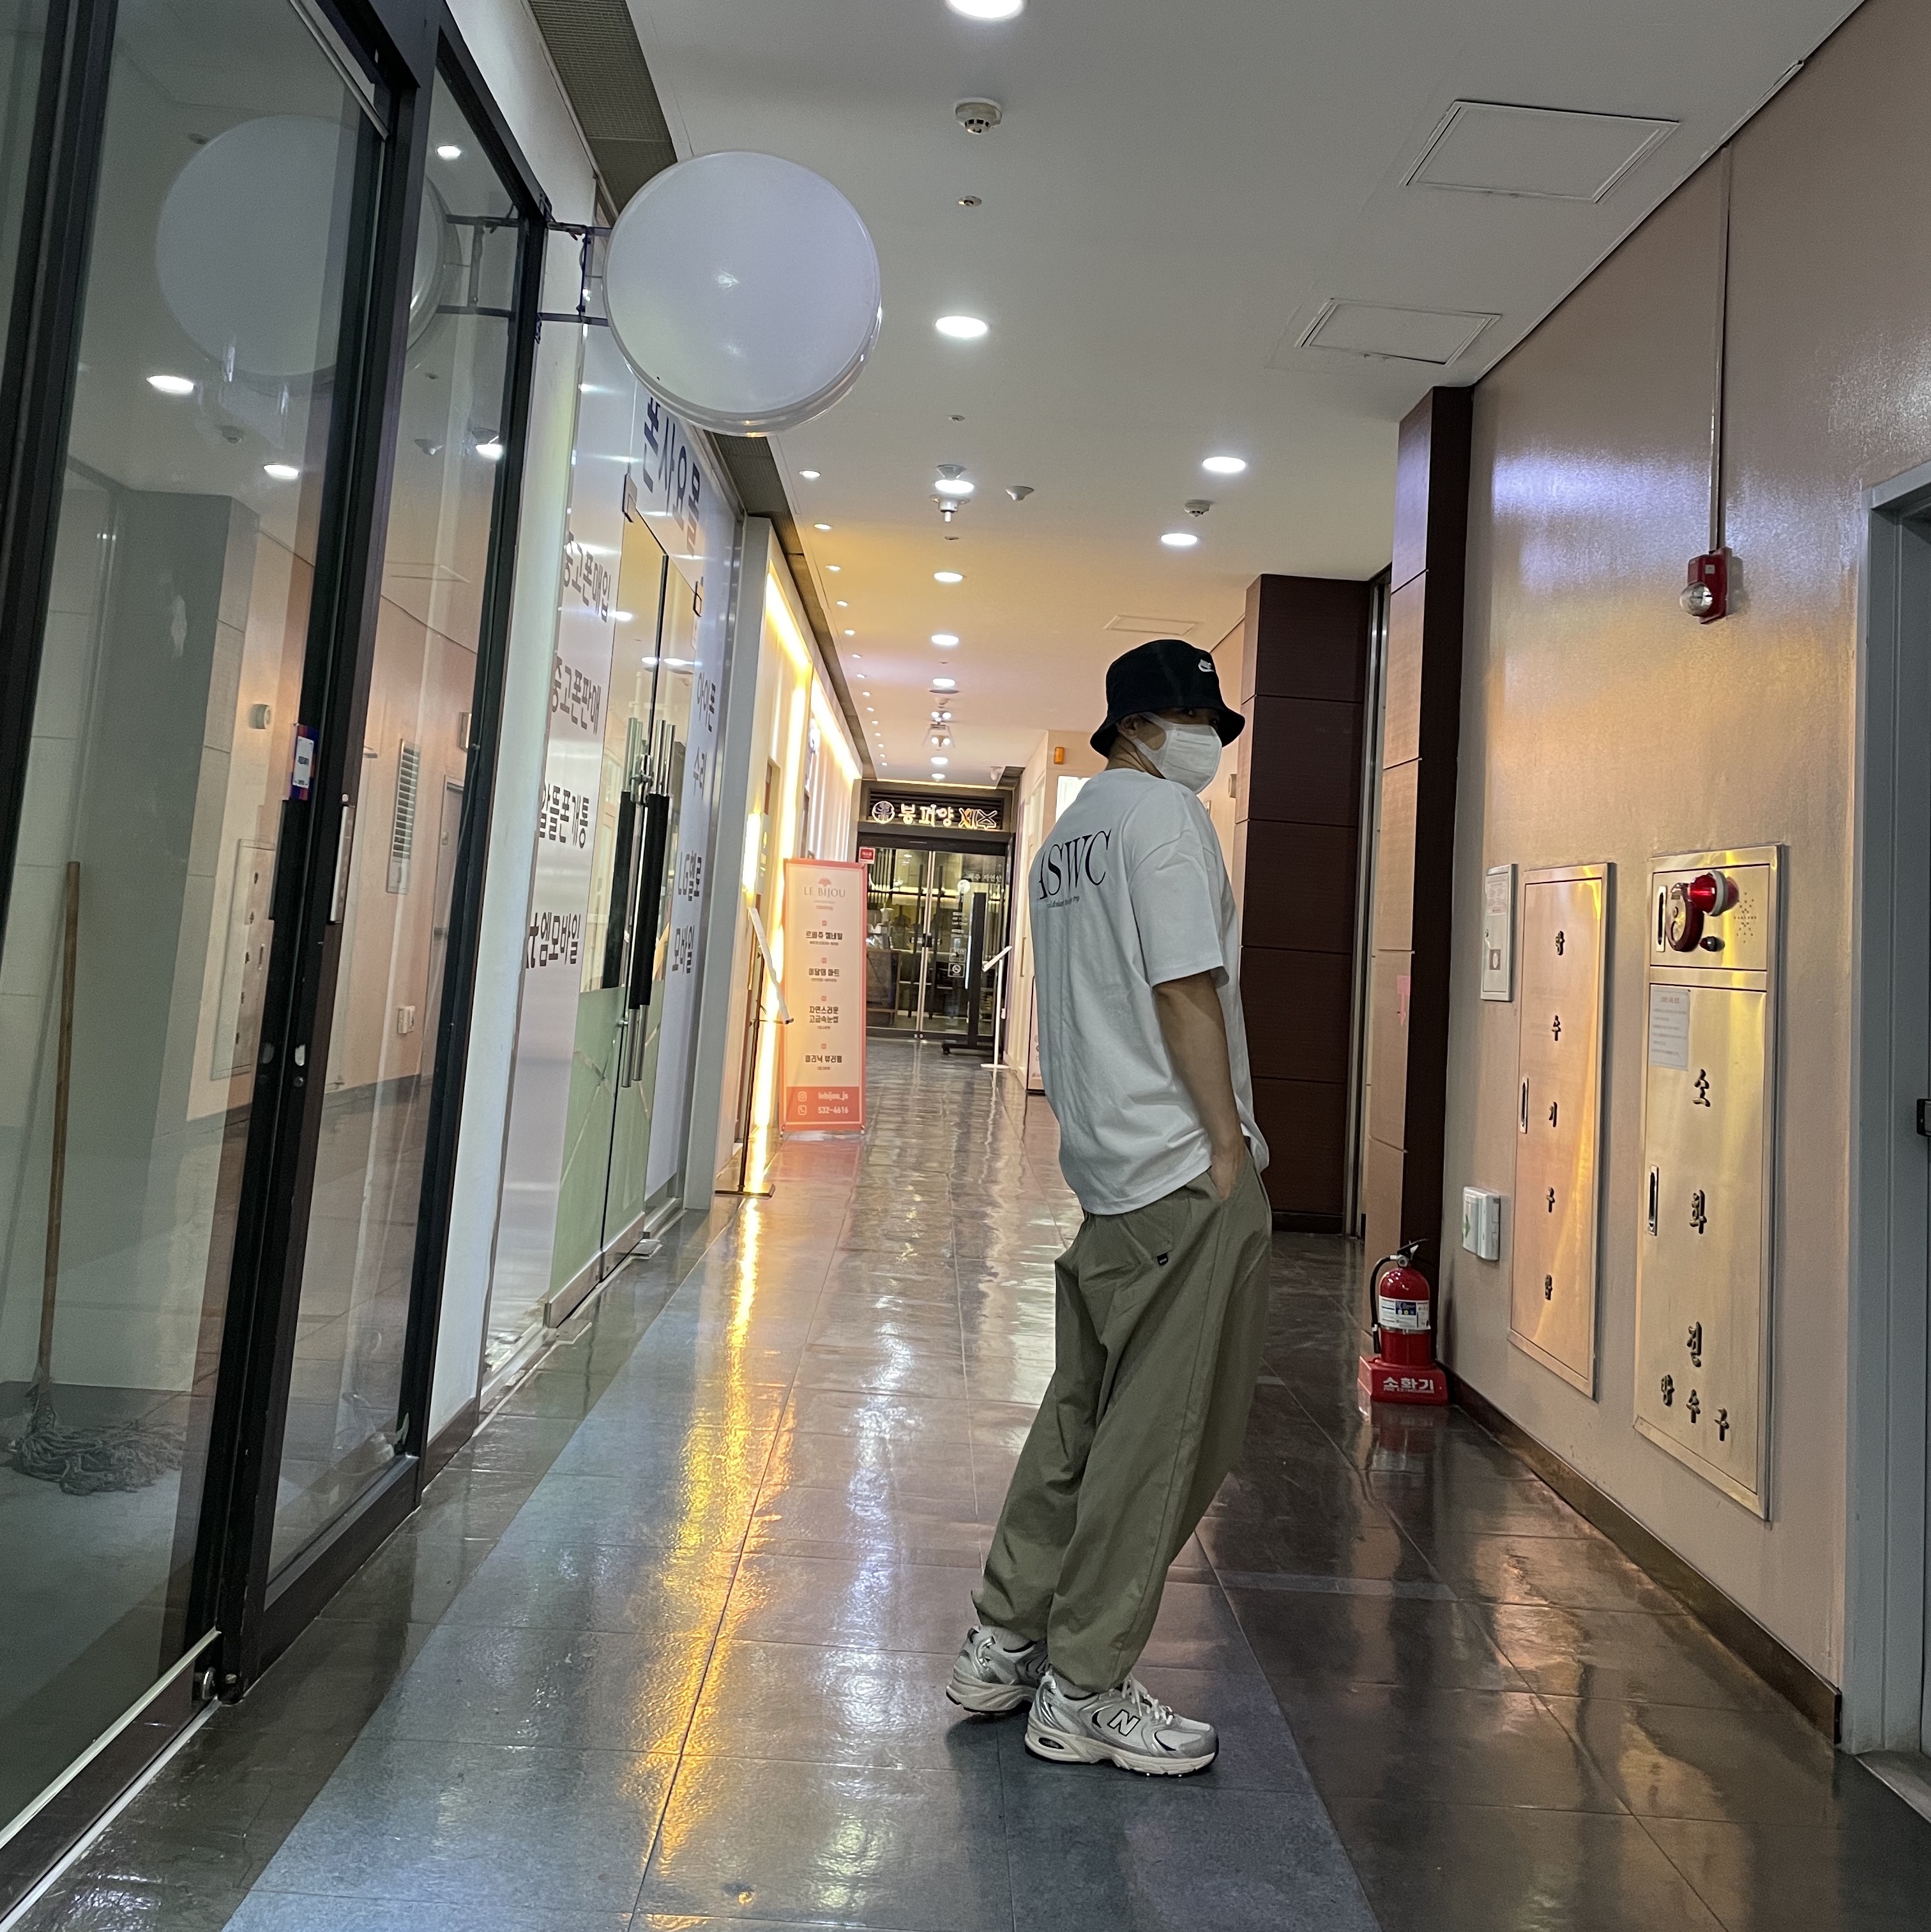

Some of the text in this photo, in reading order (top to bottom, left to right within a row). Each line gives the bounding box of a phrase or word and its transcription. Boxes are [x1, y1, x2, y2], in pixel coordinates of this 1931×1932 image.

[564, 531, 611, 623] 중고폰매입
[552, 656, 601, 734] 중고폰판매
[697, 673, 716, 733] 아이폰
[539, 784, 589, 849] 알뜰폰개통
[804, 886, 846, 898] LE BIJOU
[672, 925, 695, 974] 모바일
[808, 1005, 839, 1014] 자연스러운
[1382, 1376, 1435, 1390] 소화기
[1107, 1708, 1141, 1736] N
